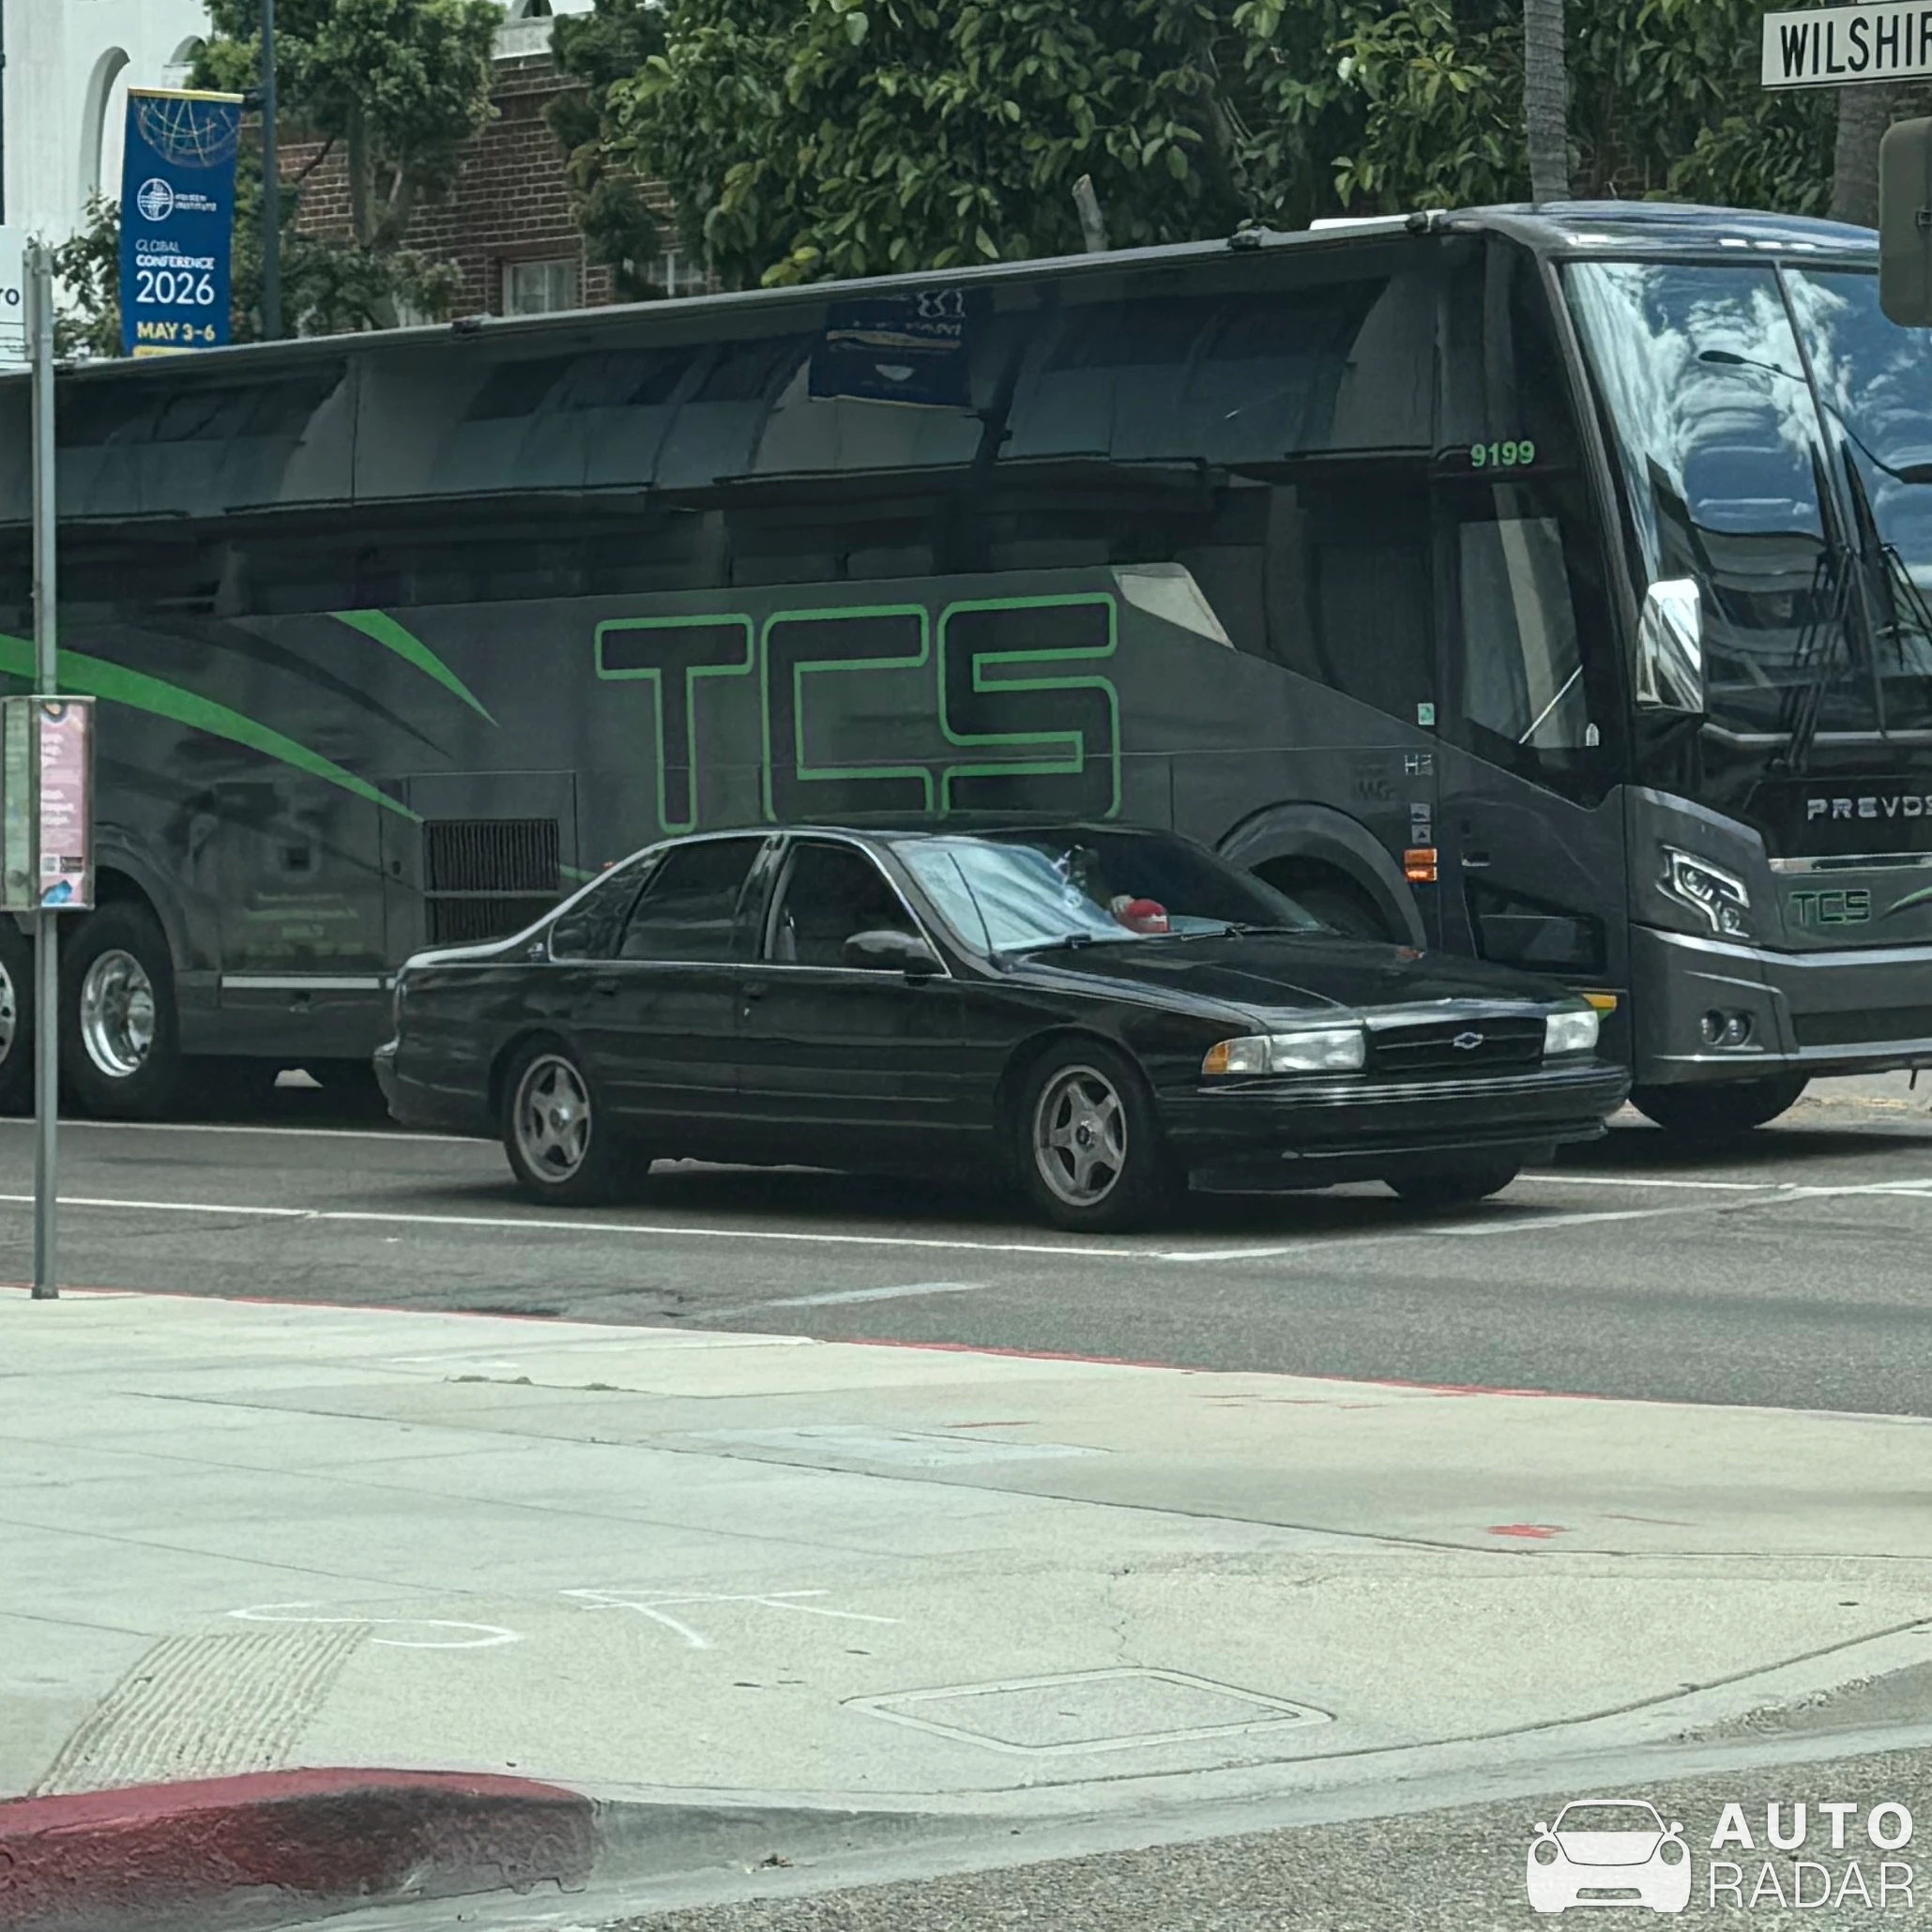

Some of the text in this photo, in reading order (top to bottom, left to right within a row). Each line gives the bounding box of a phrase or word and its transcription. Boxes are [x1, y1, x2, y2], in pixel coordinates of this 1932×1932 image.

[136, 254, 216, 269] CONFERENCE
[136, 270, 216, 305] 2026
[137, 321, 216, 342] MAY 3-6
[1470, 440, 1535, 467] 9199
[595, 592, 1120, 834] TCS
[1789, 889, 1870, 926] TCS
